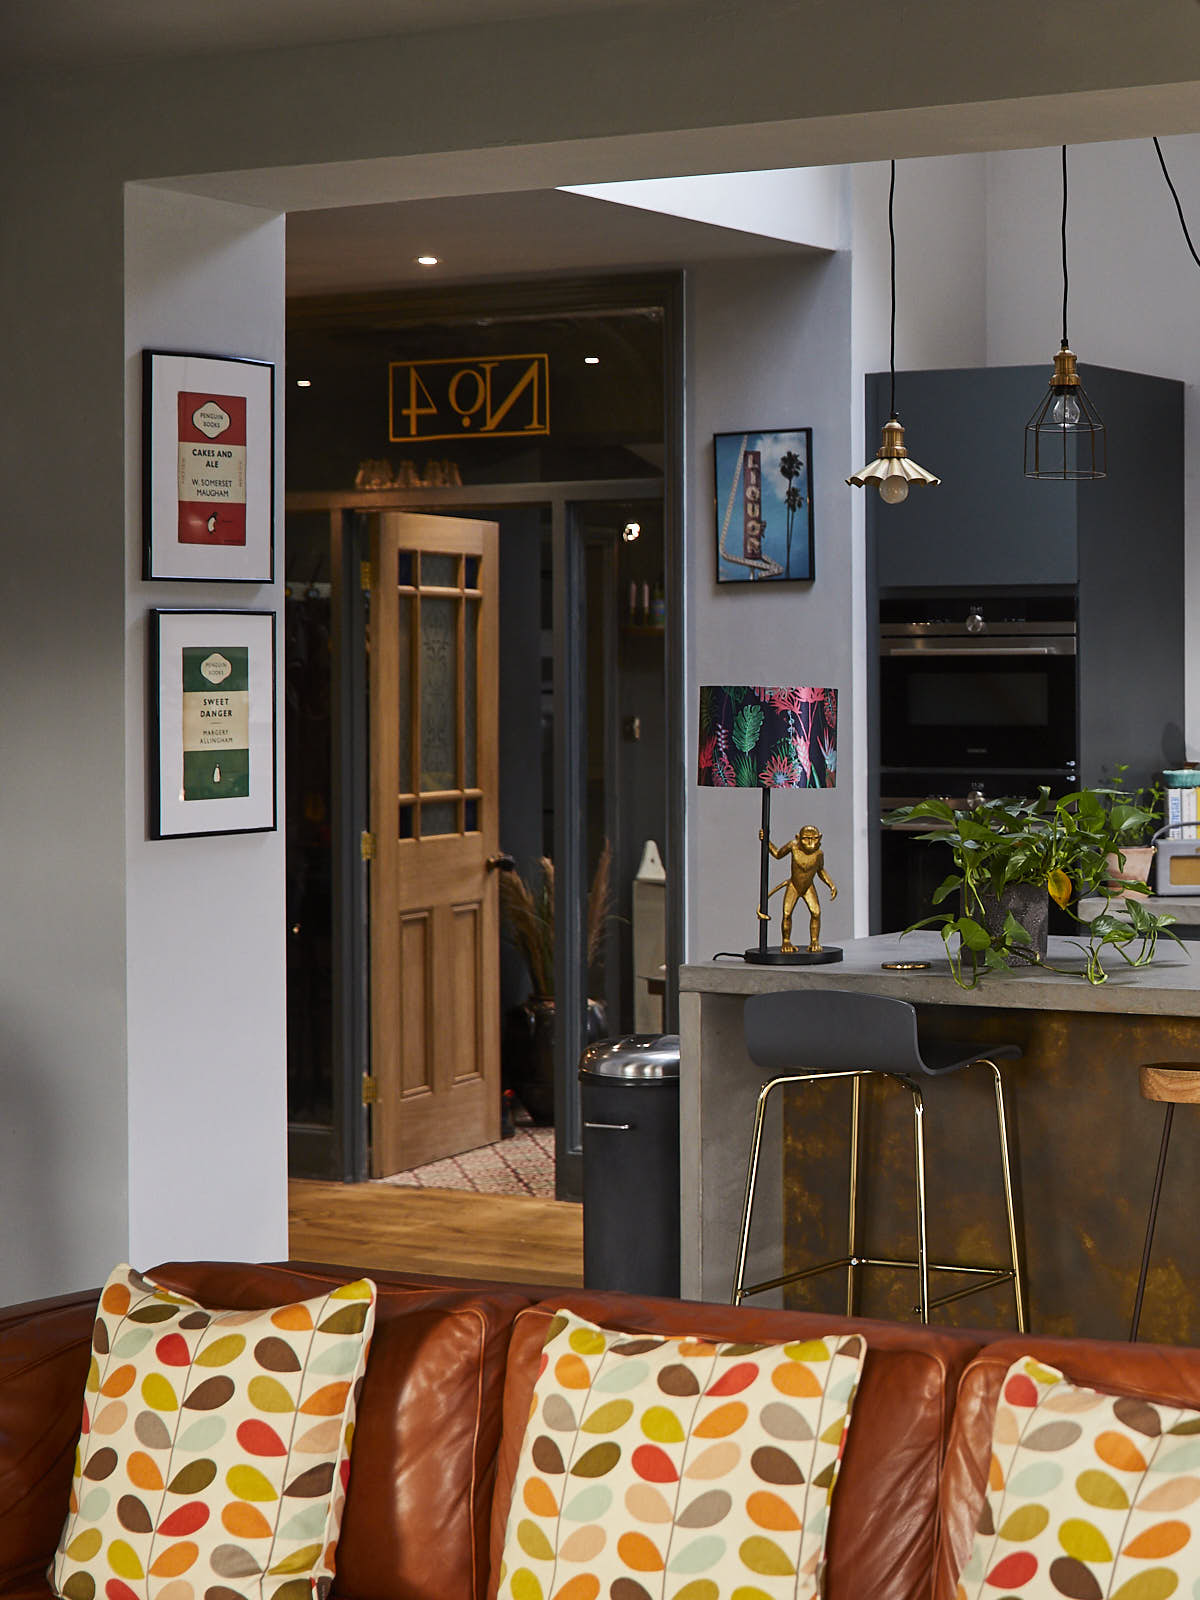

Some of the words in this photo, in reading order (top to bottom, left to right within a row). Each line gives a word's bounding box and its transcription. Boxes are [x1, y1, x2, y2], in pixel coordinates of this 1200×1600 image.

[200, 412, 224, 420] PENGUIN
[192, 448, 215, 457] CAKES
[216, 450, 233, 458] AND
[205, 460, 219, 468] ALE
[201, 479, 233, 488] SOMERSET
[196, 489, 229, 497] MAUGHAM
[746, 453, 760, 554] LIQUOR
[203, 698, 229, 706] SWEET
[200, 710, 233, 718] DANGER
[200, 737, 233, 745] ALLINGHAM
